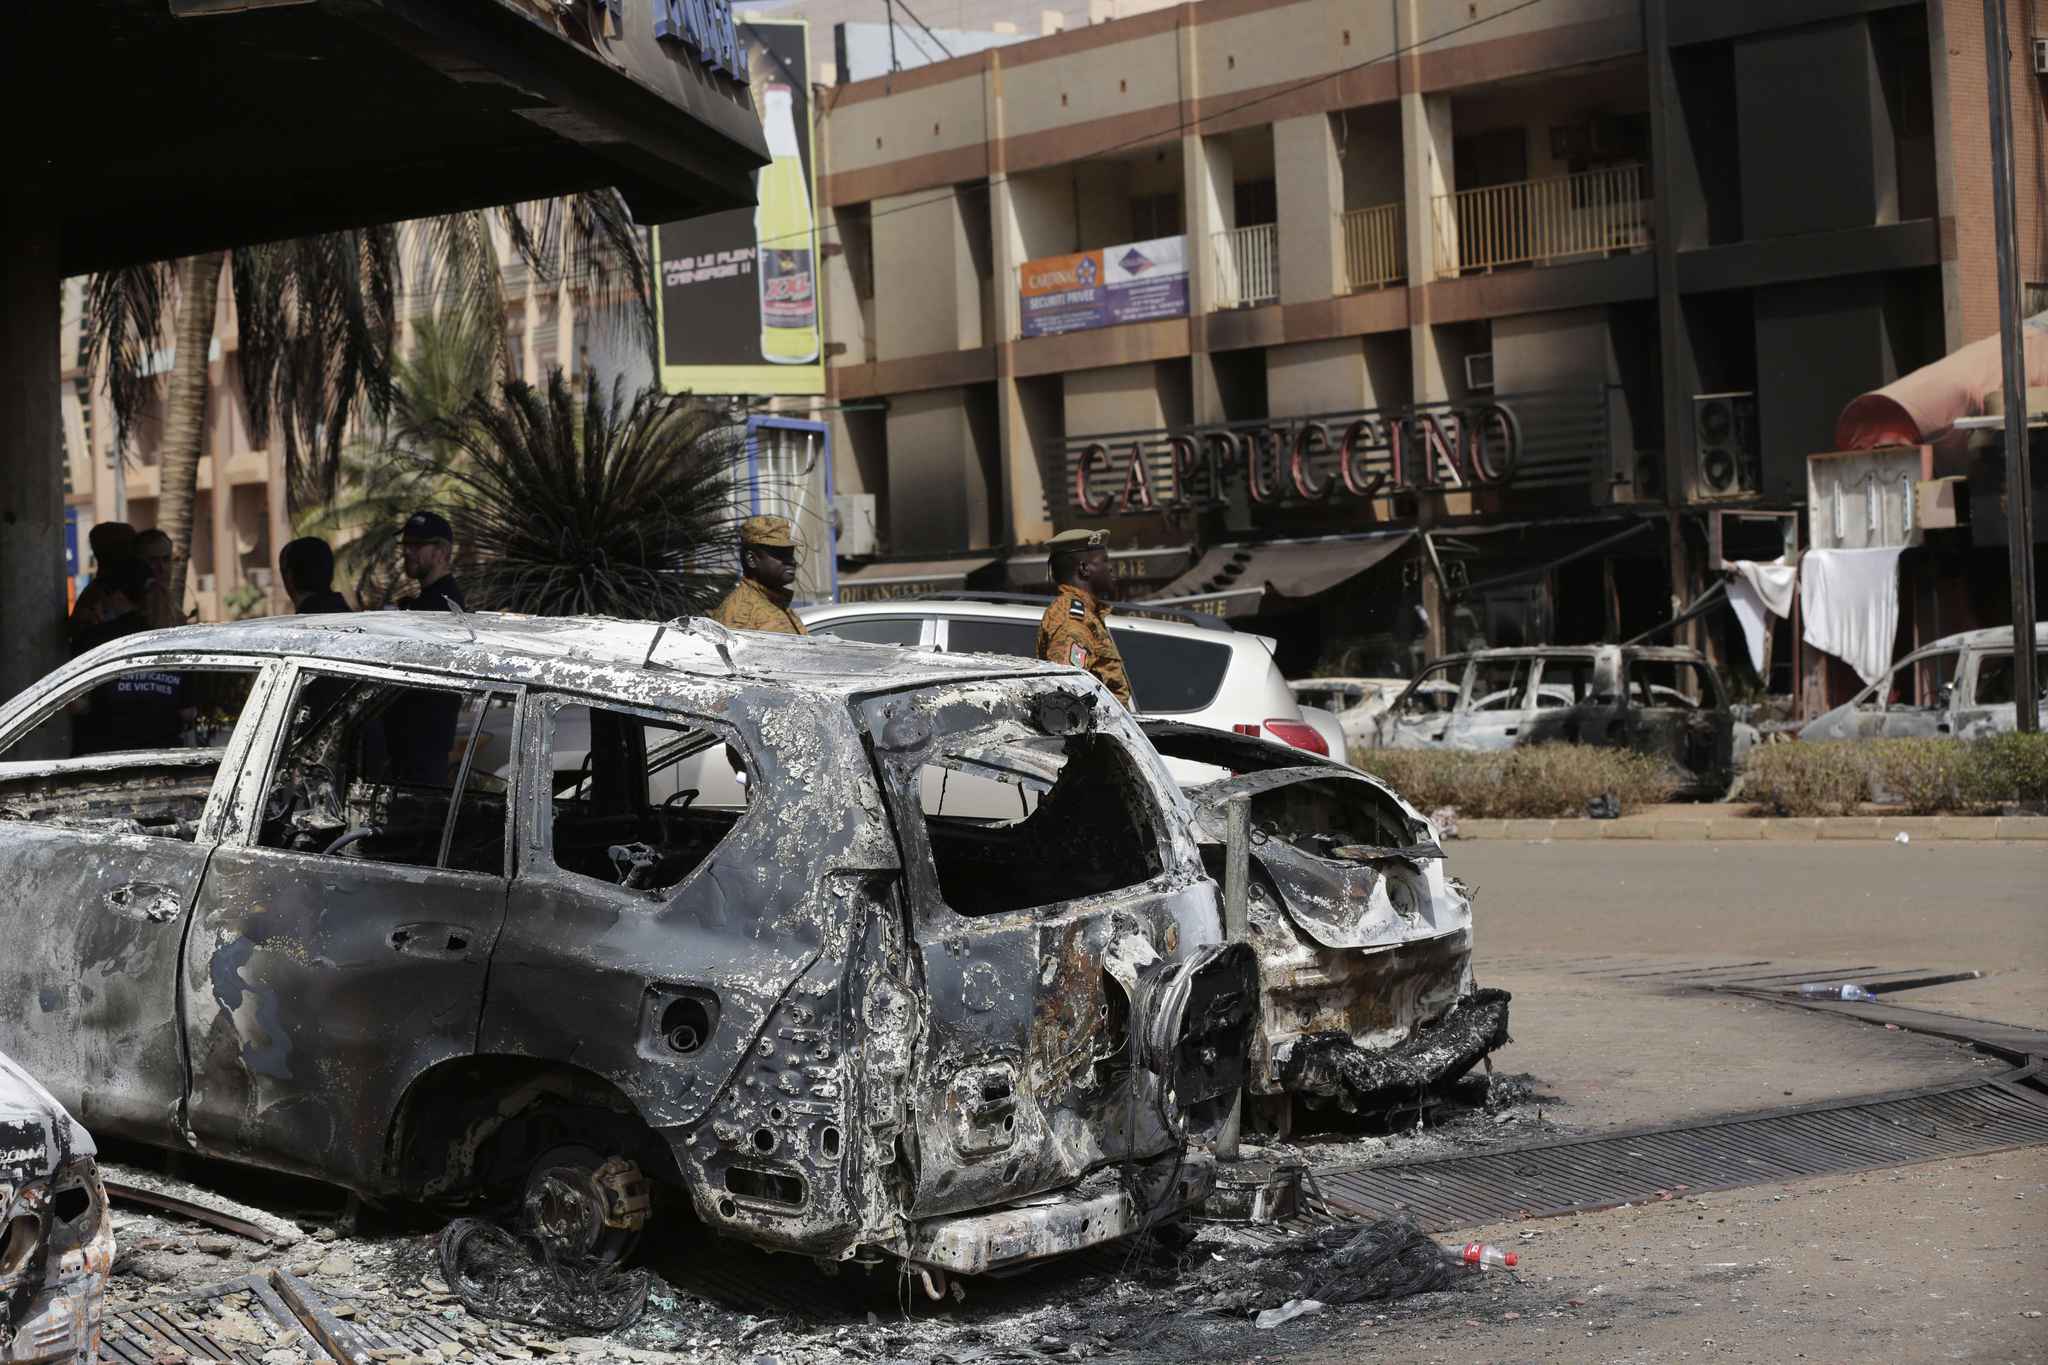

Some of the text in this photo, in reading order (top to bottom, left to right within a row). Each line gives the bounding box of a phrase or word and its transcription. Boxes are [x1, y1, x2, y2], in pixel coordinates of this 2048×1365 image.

[663, 247, 756, 274] FAIS LE PLEIN
[1075, 403, 1522, 513] CAPPUCCINO
[118, 682, 132, 692] DE
